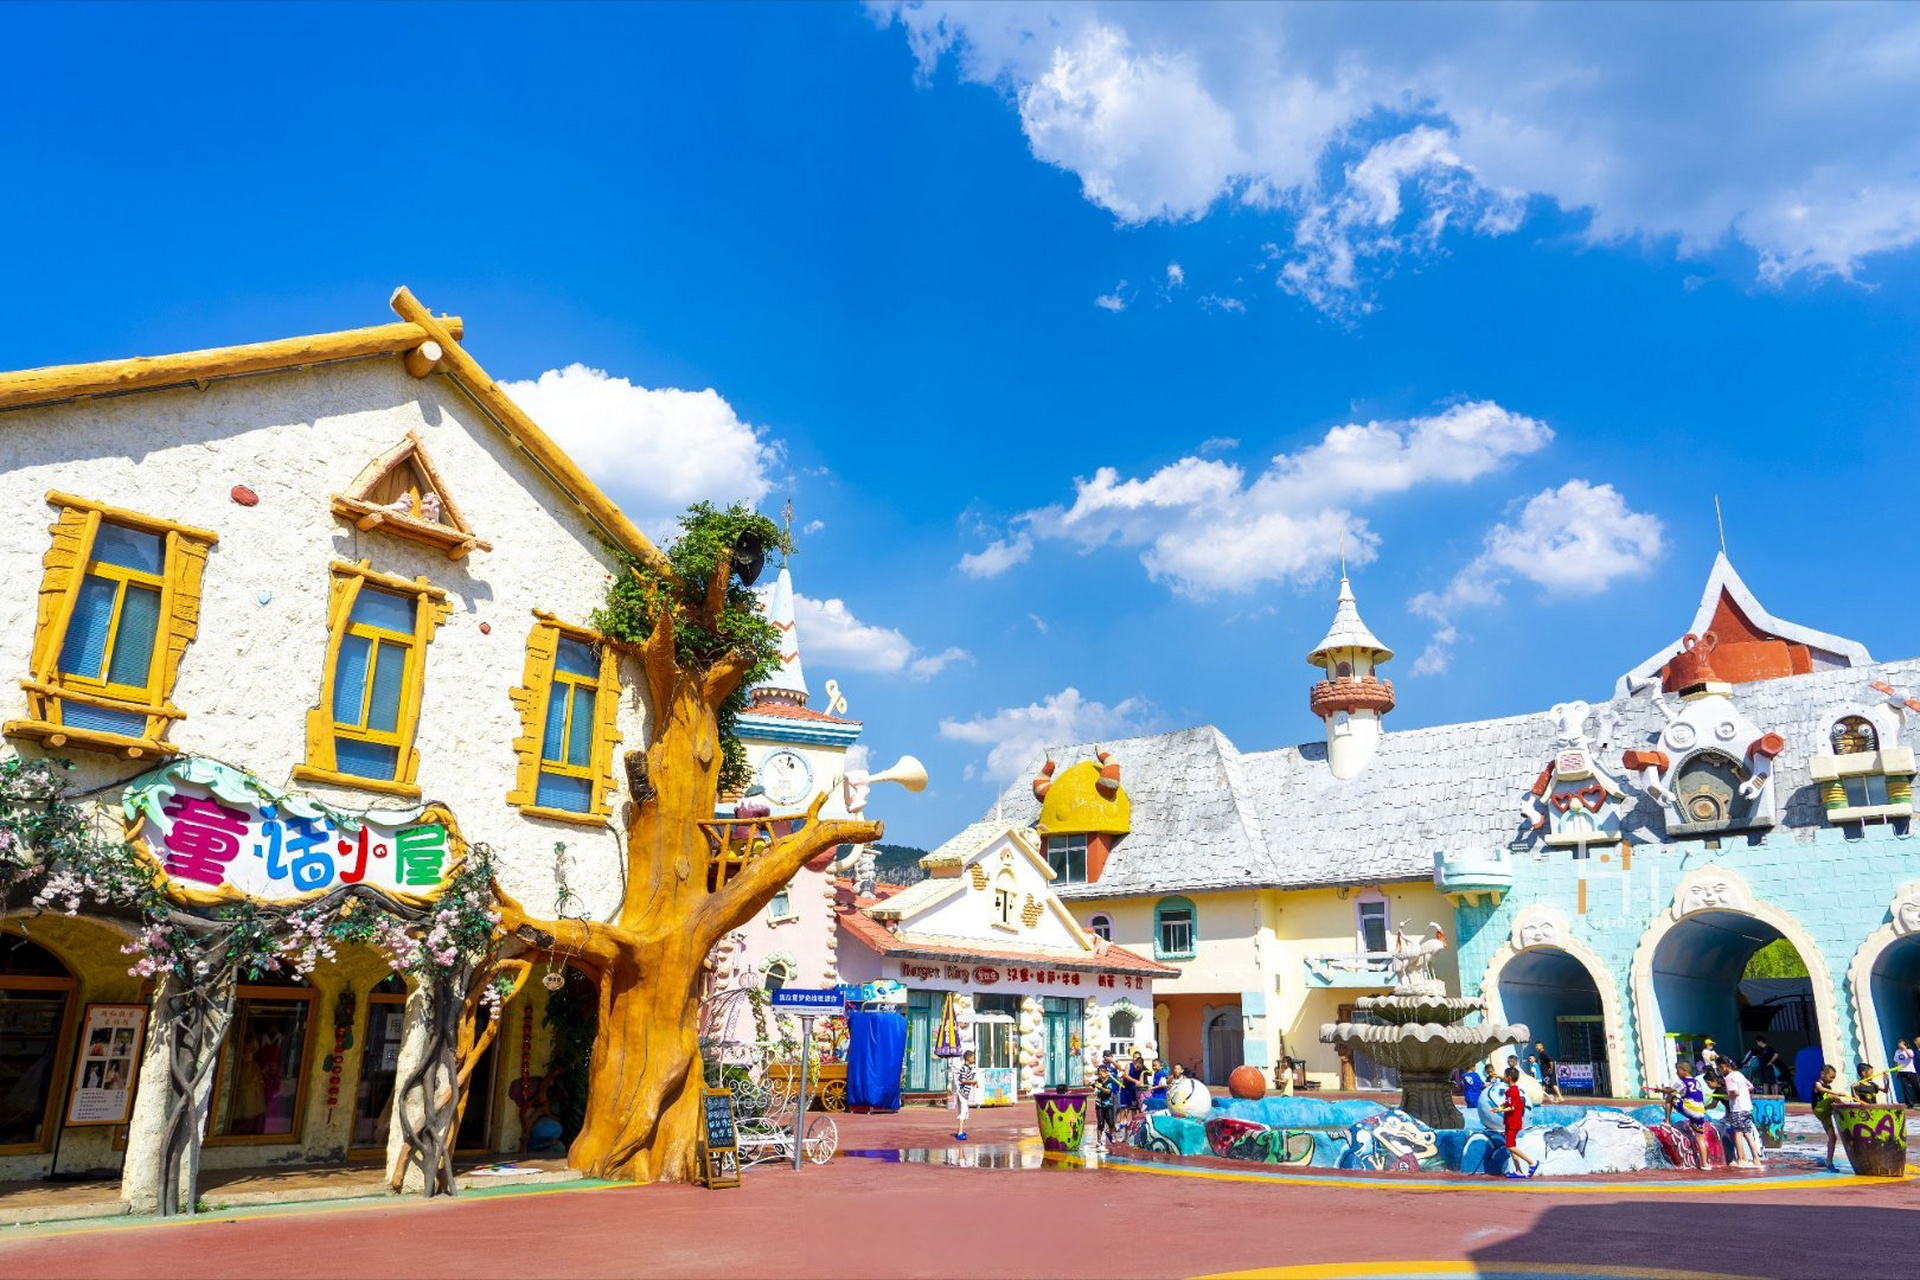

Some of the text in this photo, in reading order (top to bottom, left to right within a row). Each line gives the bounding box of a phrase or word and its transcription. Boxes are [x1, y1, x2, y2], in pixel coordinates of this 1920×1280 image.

[162, 793, 446, 891] 童话小屋
[1688, 1081, 1702, 1092] 24
